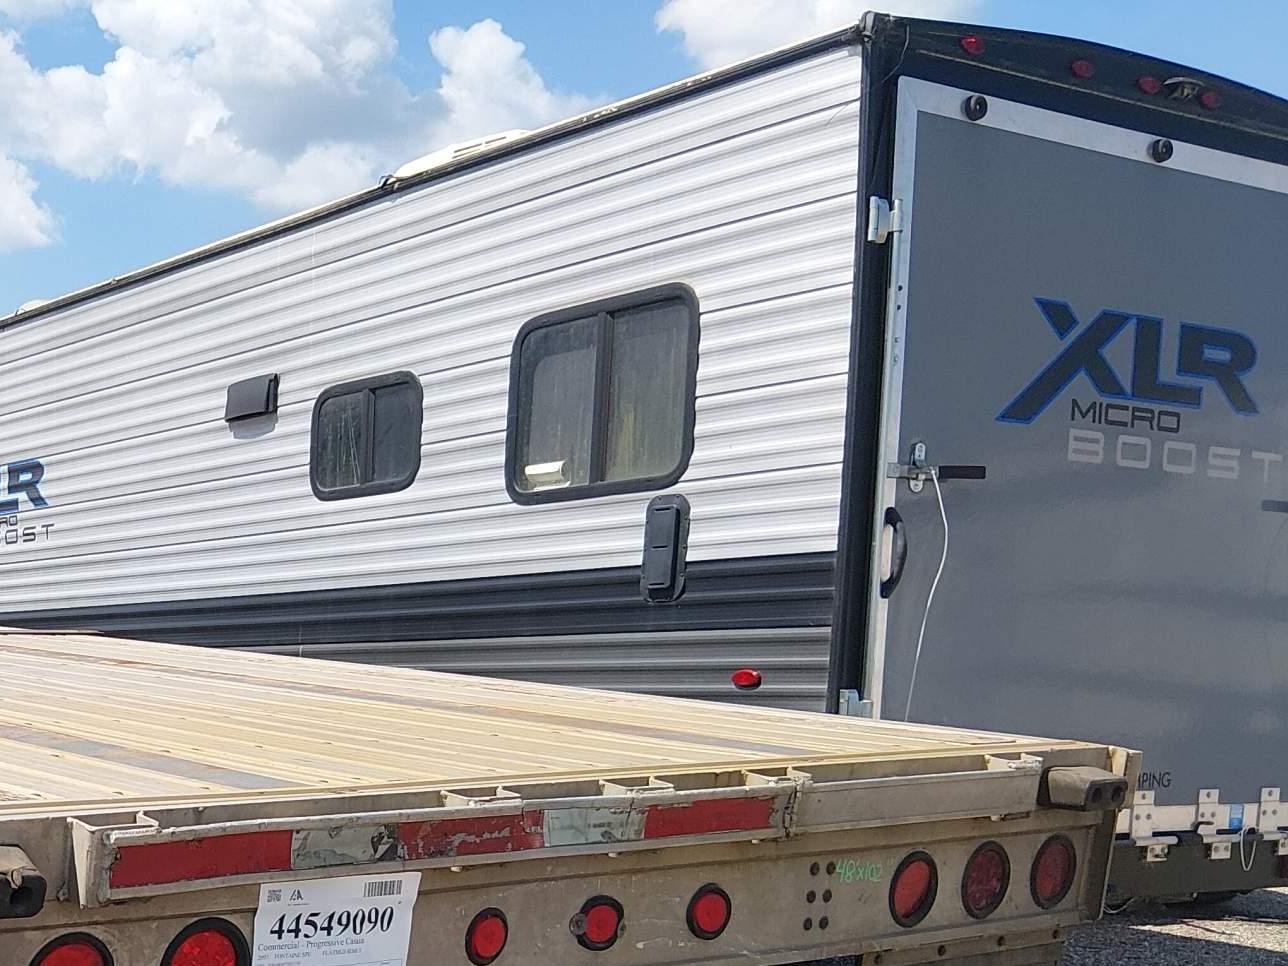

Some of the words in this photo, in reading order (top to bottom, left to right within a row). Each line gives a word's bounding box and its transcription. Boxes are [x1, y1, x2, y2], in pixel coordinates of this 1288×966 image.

[994, 297, 1260, 425] XLR
[1070, 398, 1181, 434] MICRO
[1067, 428, 1284, 482] BOOST
[270, 906, 394, 940] 44549090
[258, 942, 300, 951] Commercial
[306, 939, 344, 949] Progressive
